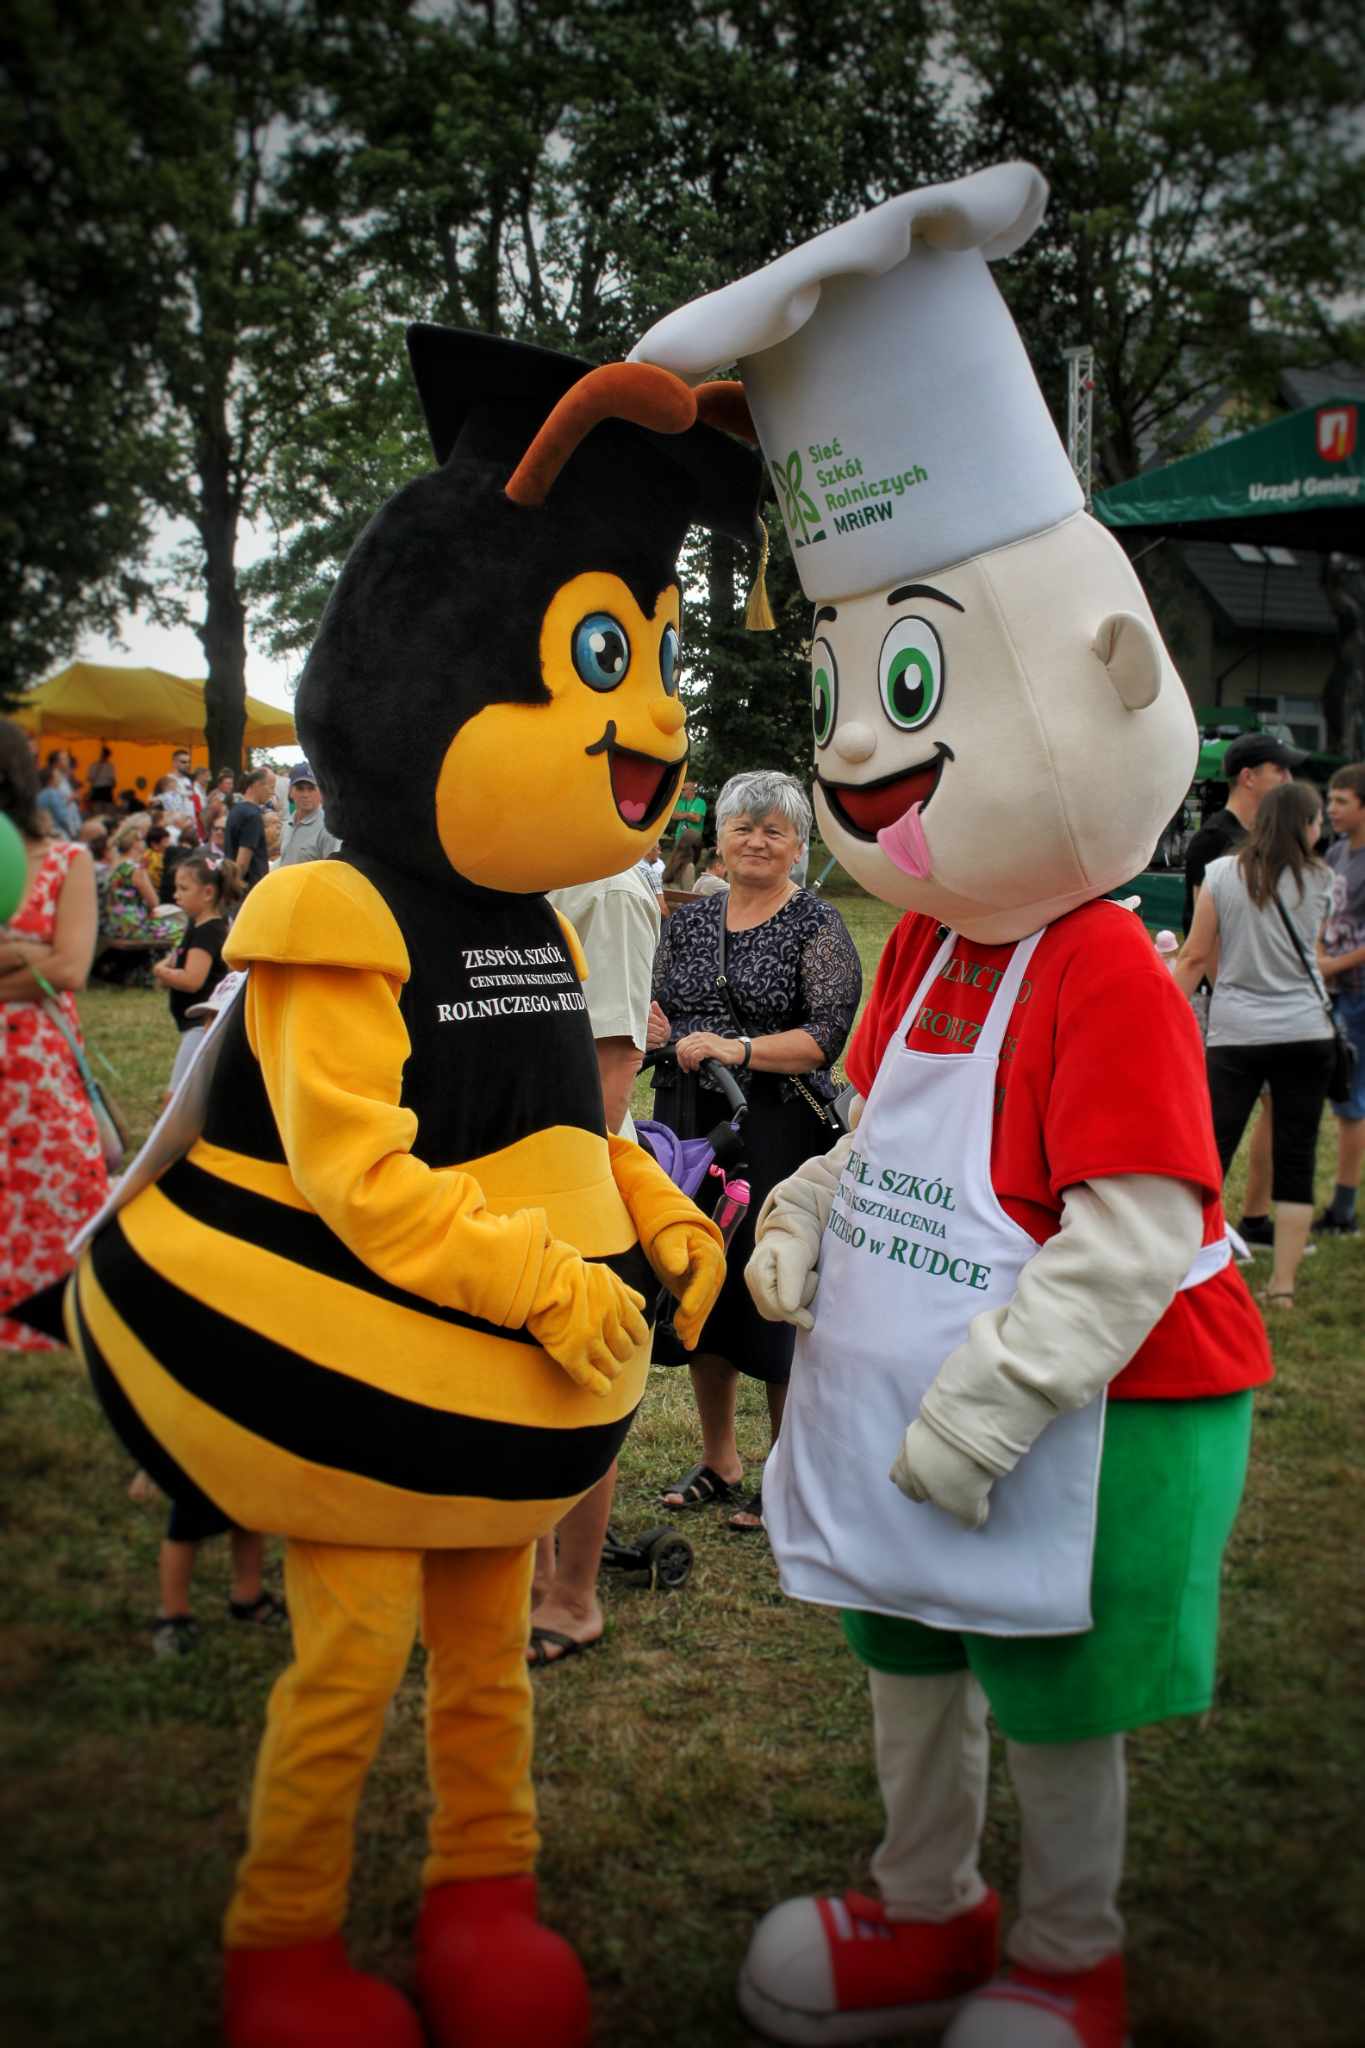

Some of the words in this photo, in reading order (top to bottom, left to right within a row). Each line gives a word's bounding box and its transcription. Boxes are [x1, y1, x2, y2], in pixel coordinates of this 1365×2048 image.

[808, 437, 843, 465] Sieć
[816, 457, 864, 488] Szkół
[825, 464, 929, 512] Rolniczych
[833, 500, 893, 536] MRiRW
[462, 945, 528, 969] ZESPÓŁ
[525, 942, 566, 966] SZKÓŁ
[470, 973, 526, 988] CENTRUM
[437, 995, 550, 1022] ROLNICZEGO
[551, 1000, 560, 1011] w
[558, 992, 586, 1011] RUD
[878, 1168, 956, 1212] SZKÓŁ
[828, 1208, 866, 1248] ICZEGO
[869, 1238, 885, 1255] w
[888, 1235, 991, 1291] RUDCE
